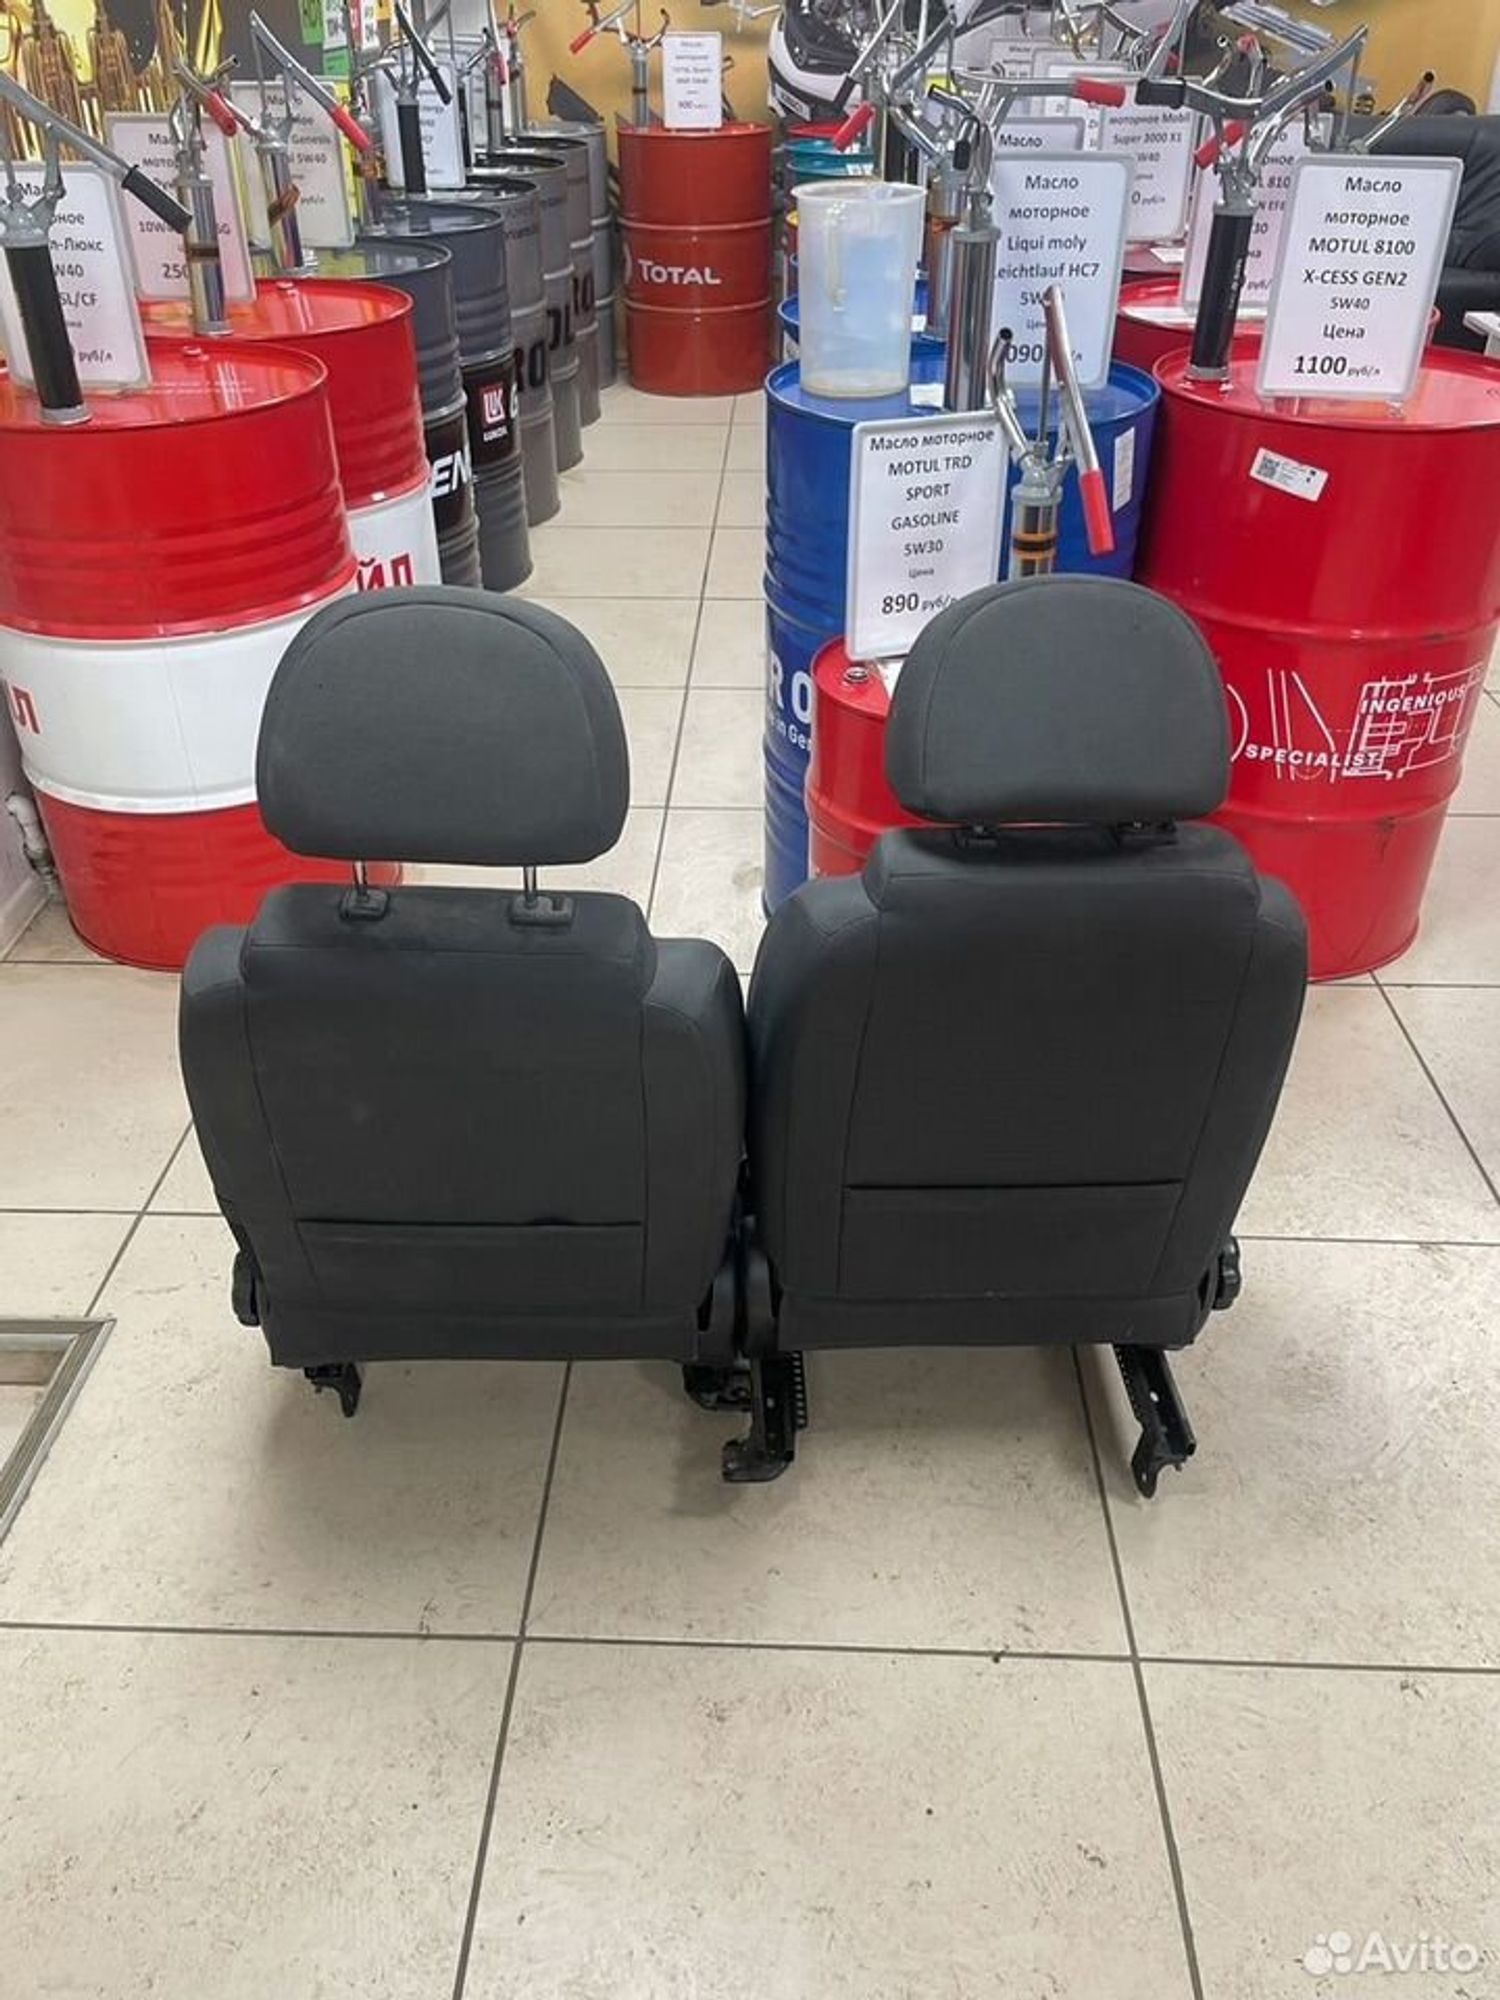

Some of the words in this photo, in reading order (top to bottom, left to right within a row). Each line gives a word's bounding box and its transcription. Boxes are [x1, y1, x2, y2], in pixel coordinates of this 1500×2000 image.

[1000, 133, 1043, 147] Масло
[1137, 151, 1161, 162] W40
[1025, 174, 1079, 190] Масло
[1345, 176, 1402, 193] Масло
[1008, 205, 1090, 221] моторное
[1324, 212, 1411, 229] моторное
[1007, 235, 1045, 252] Liqui
[1048, 236, 1087, 253] moly
[1308, 237, 1371, 254] MOTUL
[1374, 239, 1416, 255] 8100
[637, 258, 722, 285] TOTAL
[996, 262, 1065, 279] eichtlauf
[1068, 262, 1101, 277] HC7
[1303, 268, 1359, 286] X-CESS
[1362, 270, 1408, 287] GEN2
[1329, 297, 1370, 311] 5W40
[1322, 323, 1366, 340] Цена
[1293, 355, 1347, 375] 1100
[1347, 364, 1381, 377] руб/л
[870, 436, 918, 451] Масло
[922, 429, 995, 447] моторное
[888, 460, 941, 476] MOTUL
[944, 455, 973, 470] TRD
[906, 483, 951, 501] SPORT
[891, 511, 960, 531] GASOLINE
[903, 540, 944, 557] 5W30
[908, 568, 935, 579] Цена
[881, 593, 919, 615] 890
[1360, 686, 1467, 716] INGENIOUS
[1245, 744, 1381, 767] SPECIALIST
